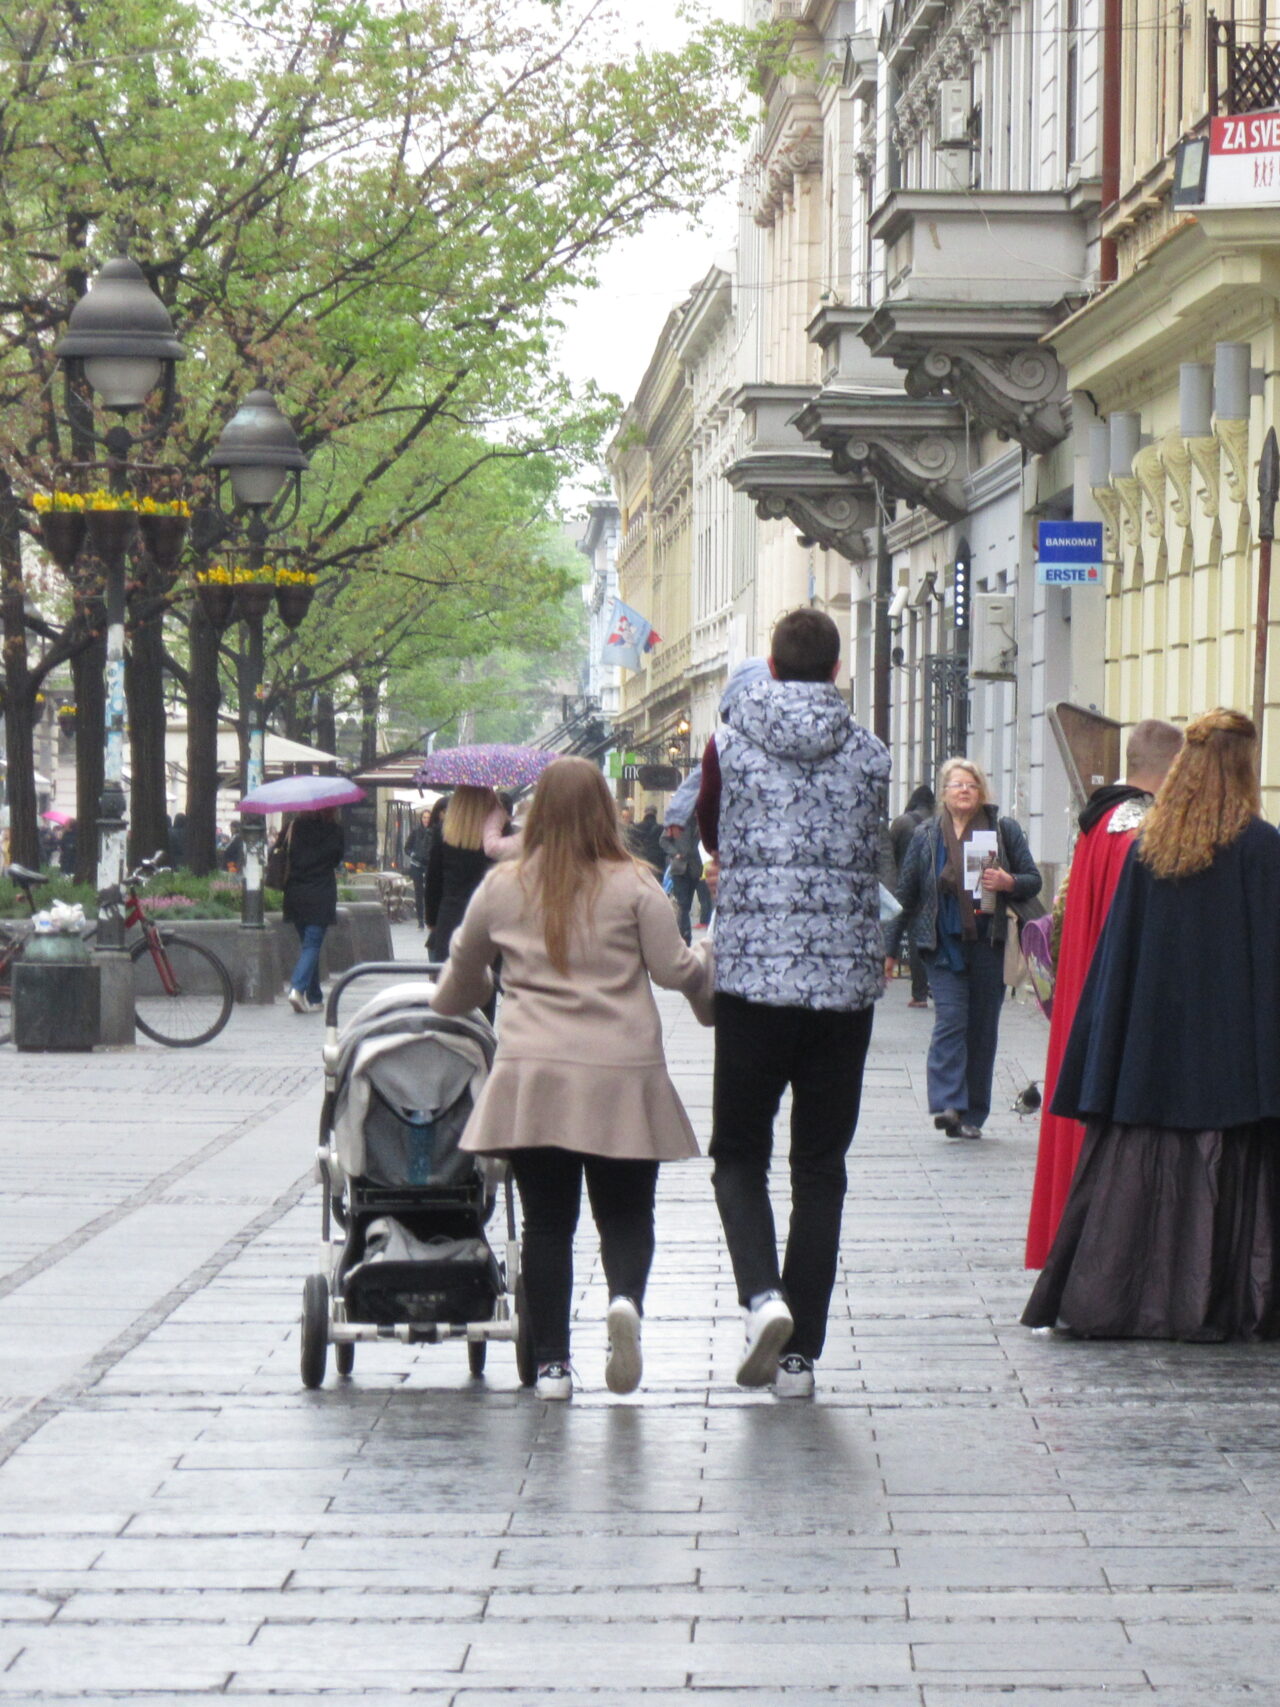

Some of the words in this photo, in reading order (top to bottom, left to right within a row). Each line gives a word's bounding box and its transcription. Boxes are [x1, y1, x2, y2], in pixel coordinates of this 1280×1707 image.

[1222, 121, 1247, 149] ZA
[1045, 538, 1098, 547] BANKOMAT
[1046, 569, 1086, 581] ERSTE
